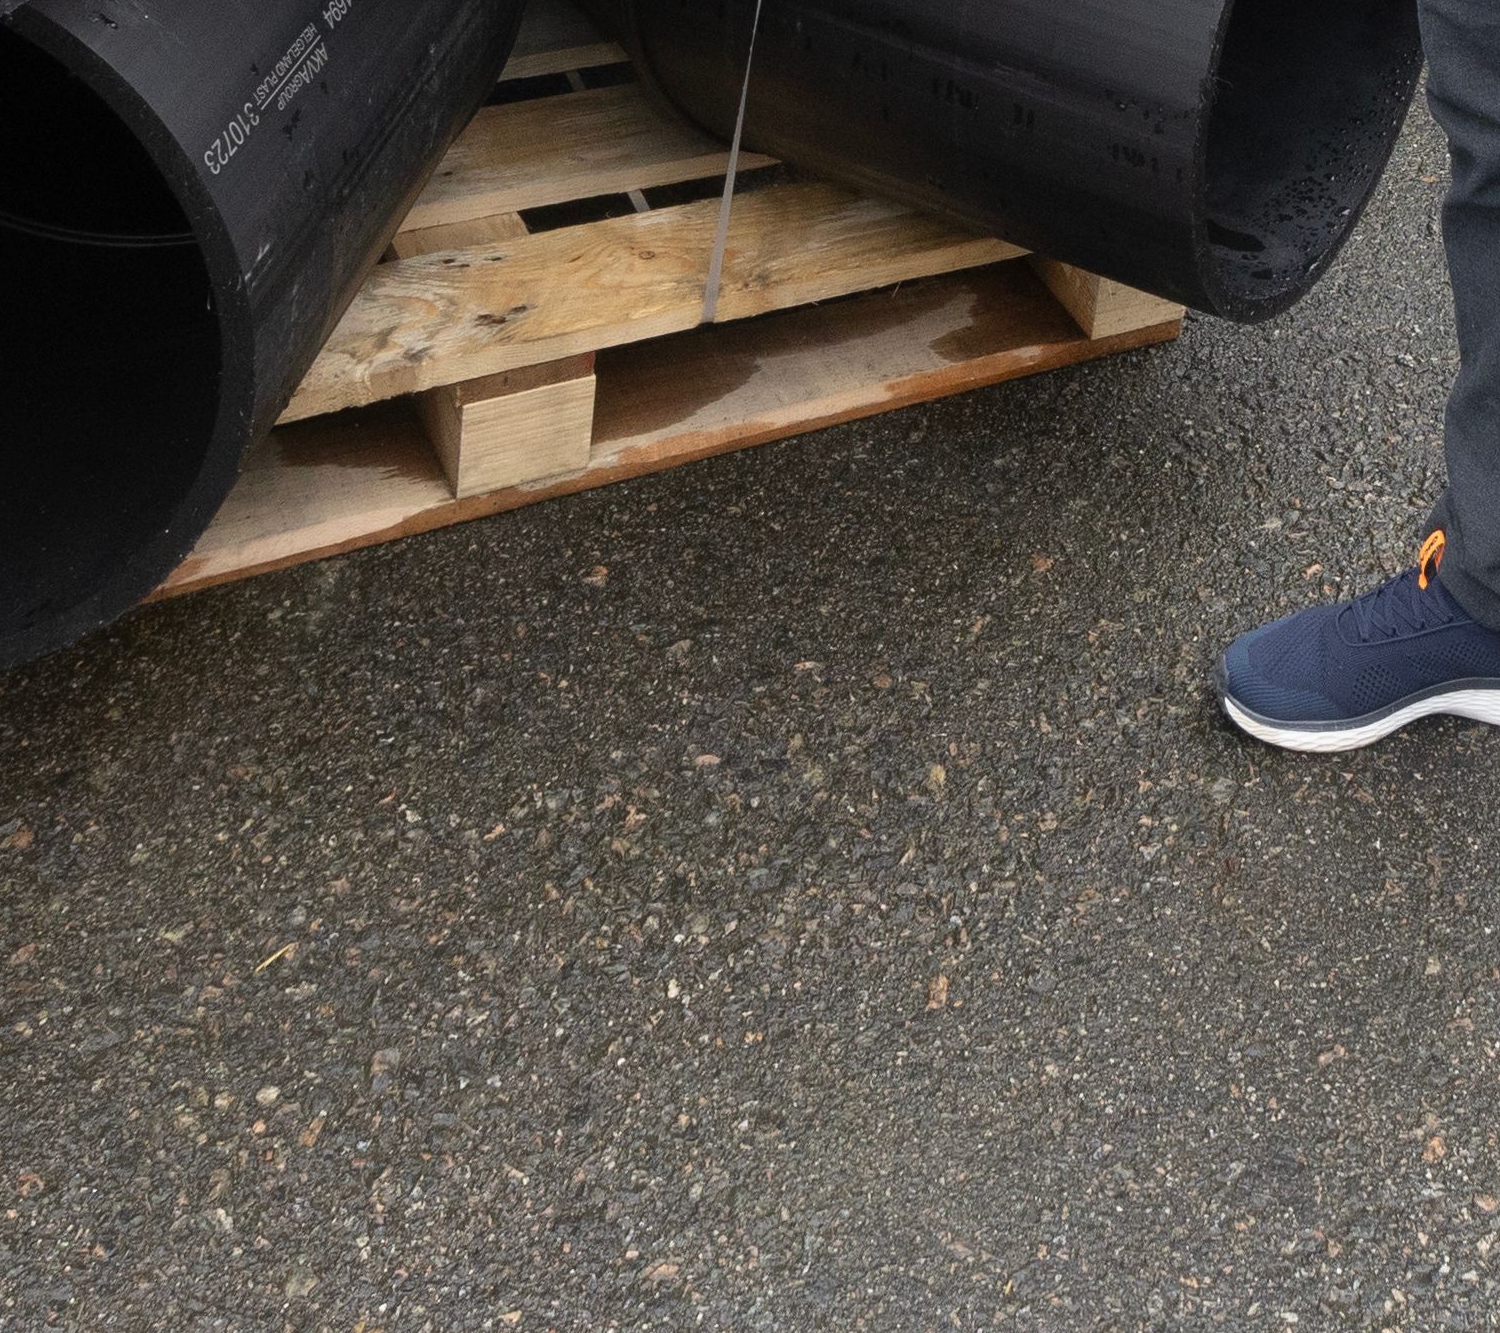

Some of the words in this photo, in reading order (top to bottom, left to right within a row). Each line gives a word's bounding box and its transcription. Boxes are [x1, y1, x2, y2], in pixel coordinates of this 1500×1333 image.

[275, 22, 319, 77] HELGELAND
[277, 41, 330, 111] AKVAGROUP
[253, 70, 280, 107] PLAST
[203, 102, 260, 175] 310723
